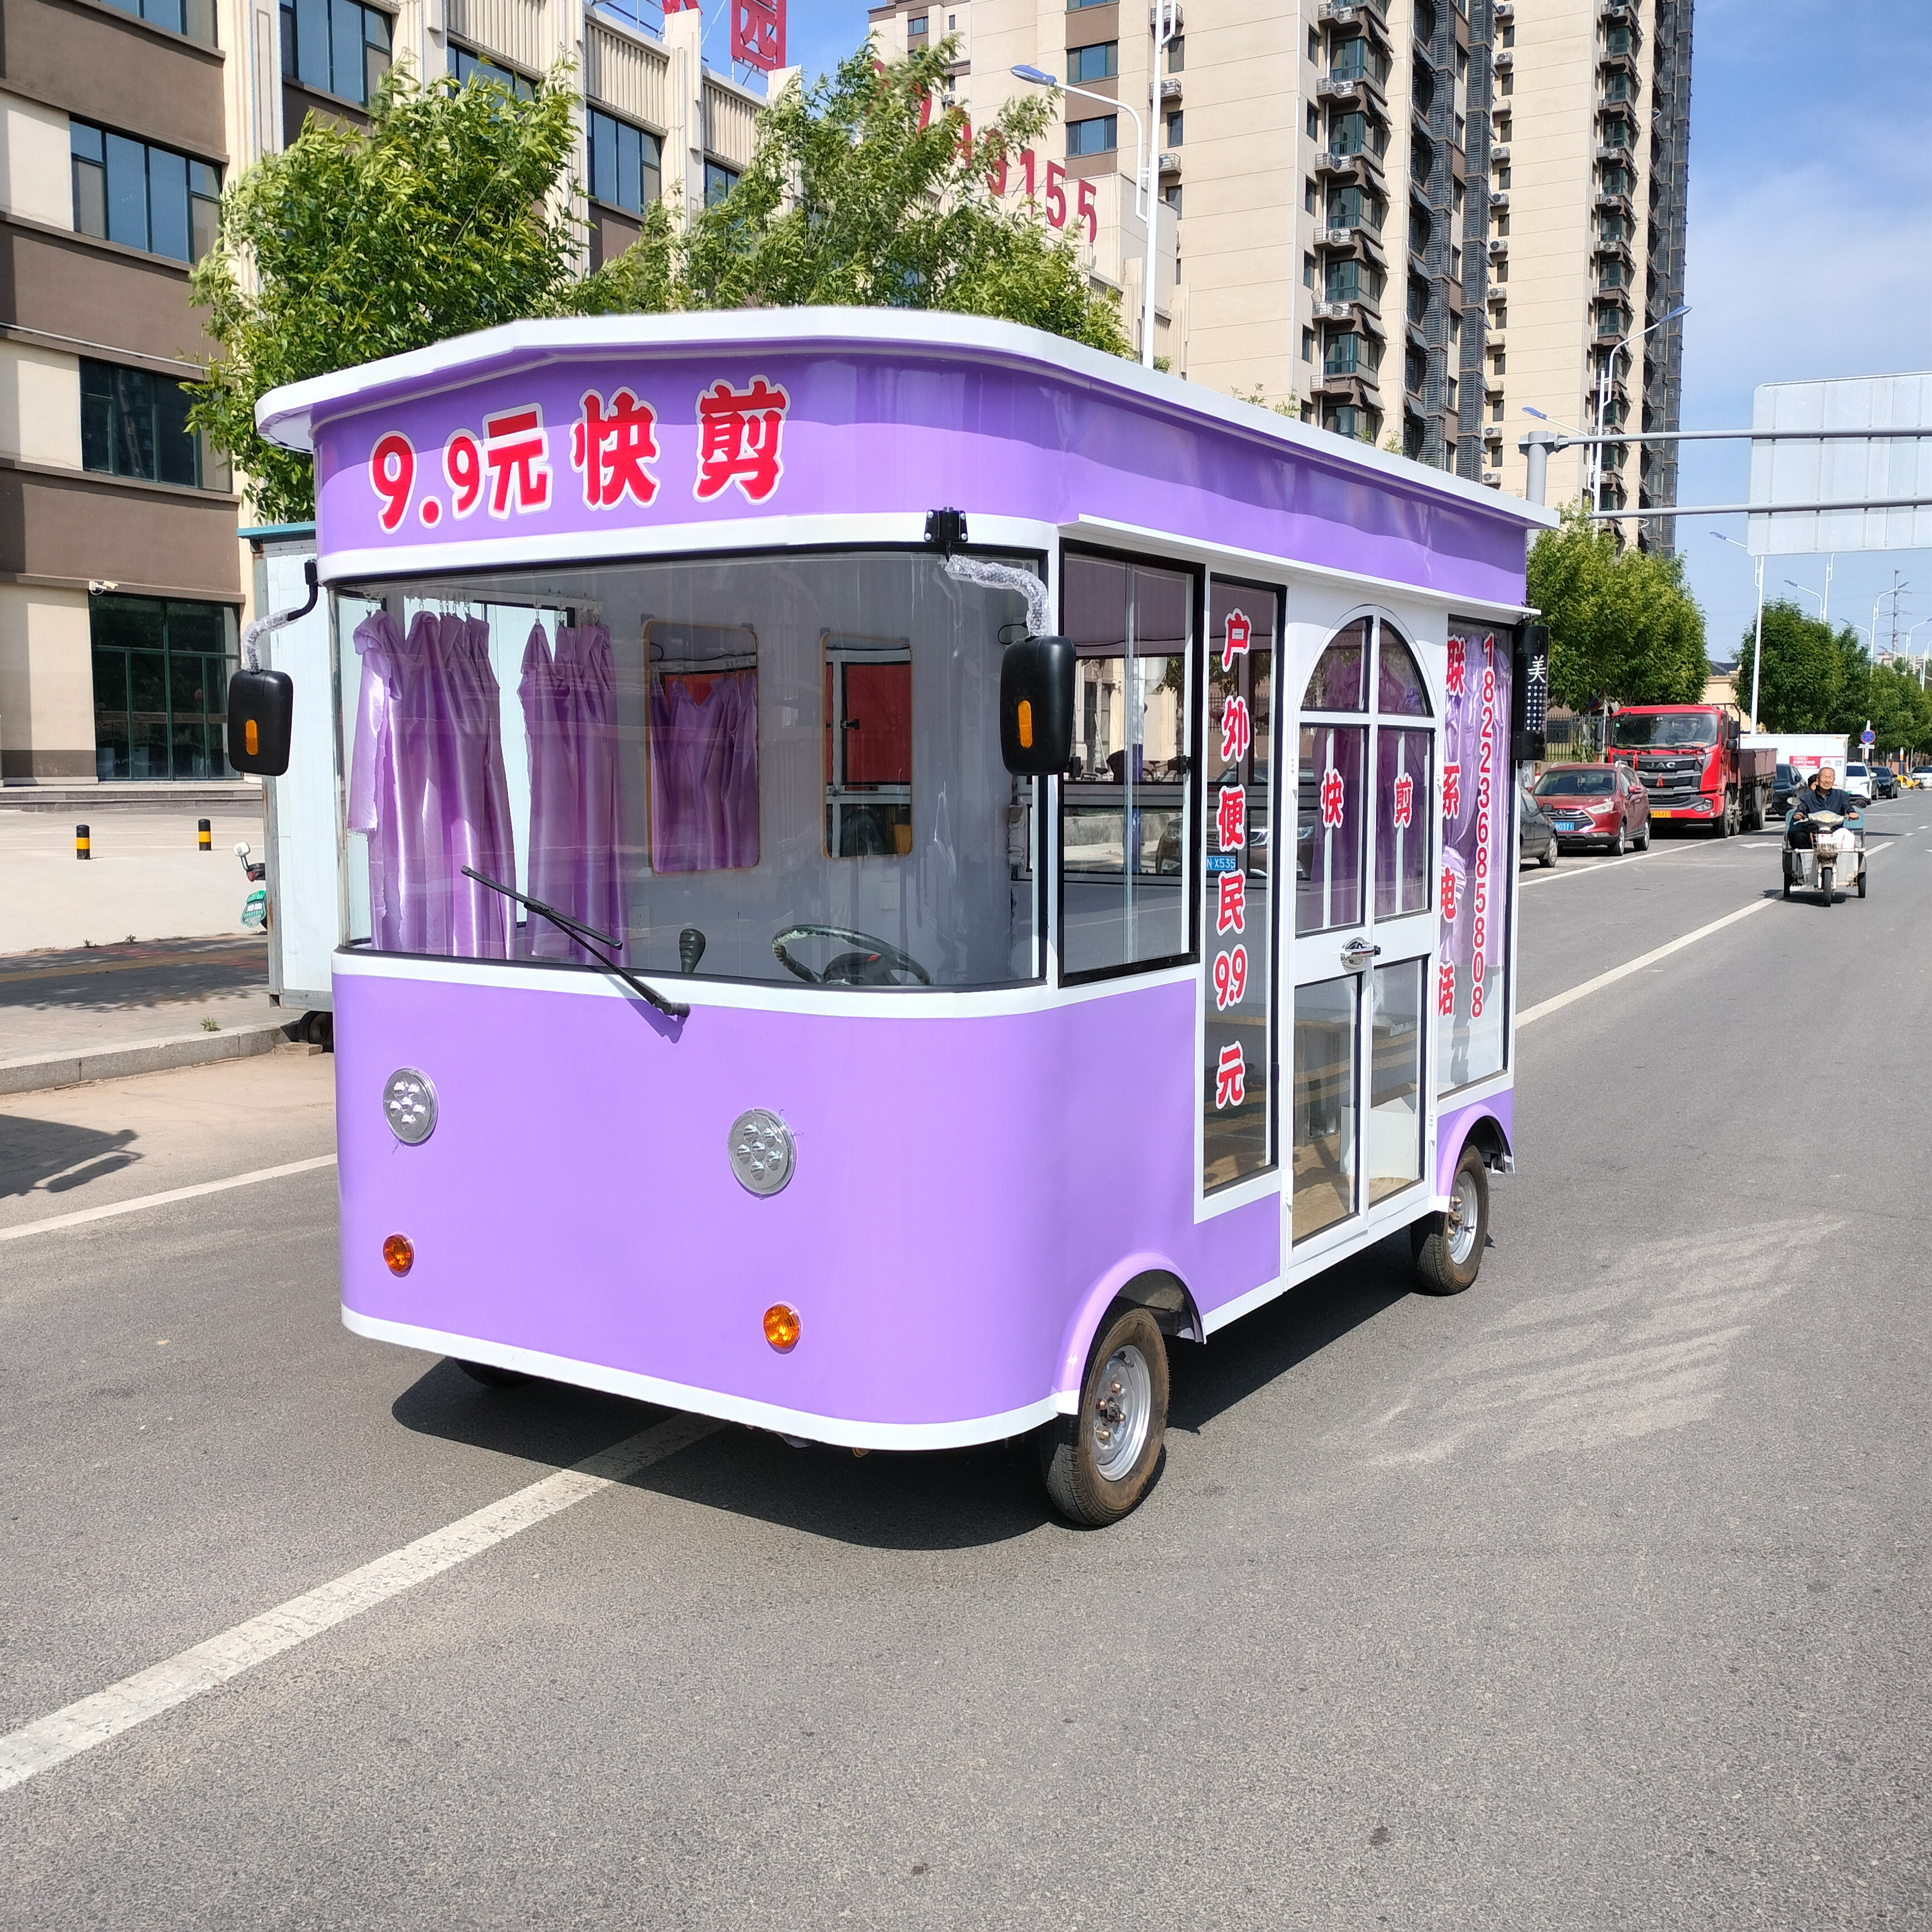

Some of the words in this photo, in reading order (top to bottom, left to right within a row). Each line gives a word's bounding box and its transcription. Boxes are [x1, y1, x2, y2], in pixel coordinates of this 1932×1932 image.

[1439, 638, 1465, 1017] 联系电话
[1471, 635, 1495, 1018] 18223685808
